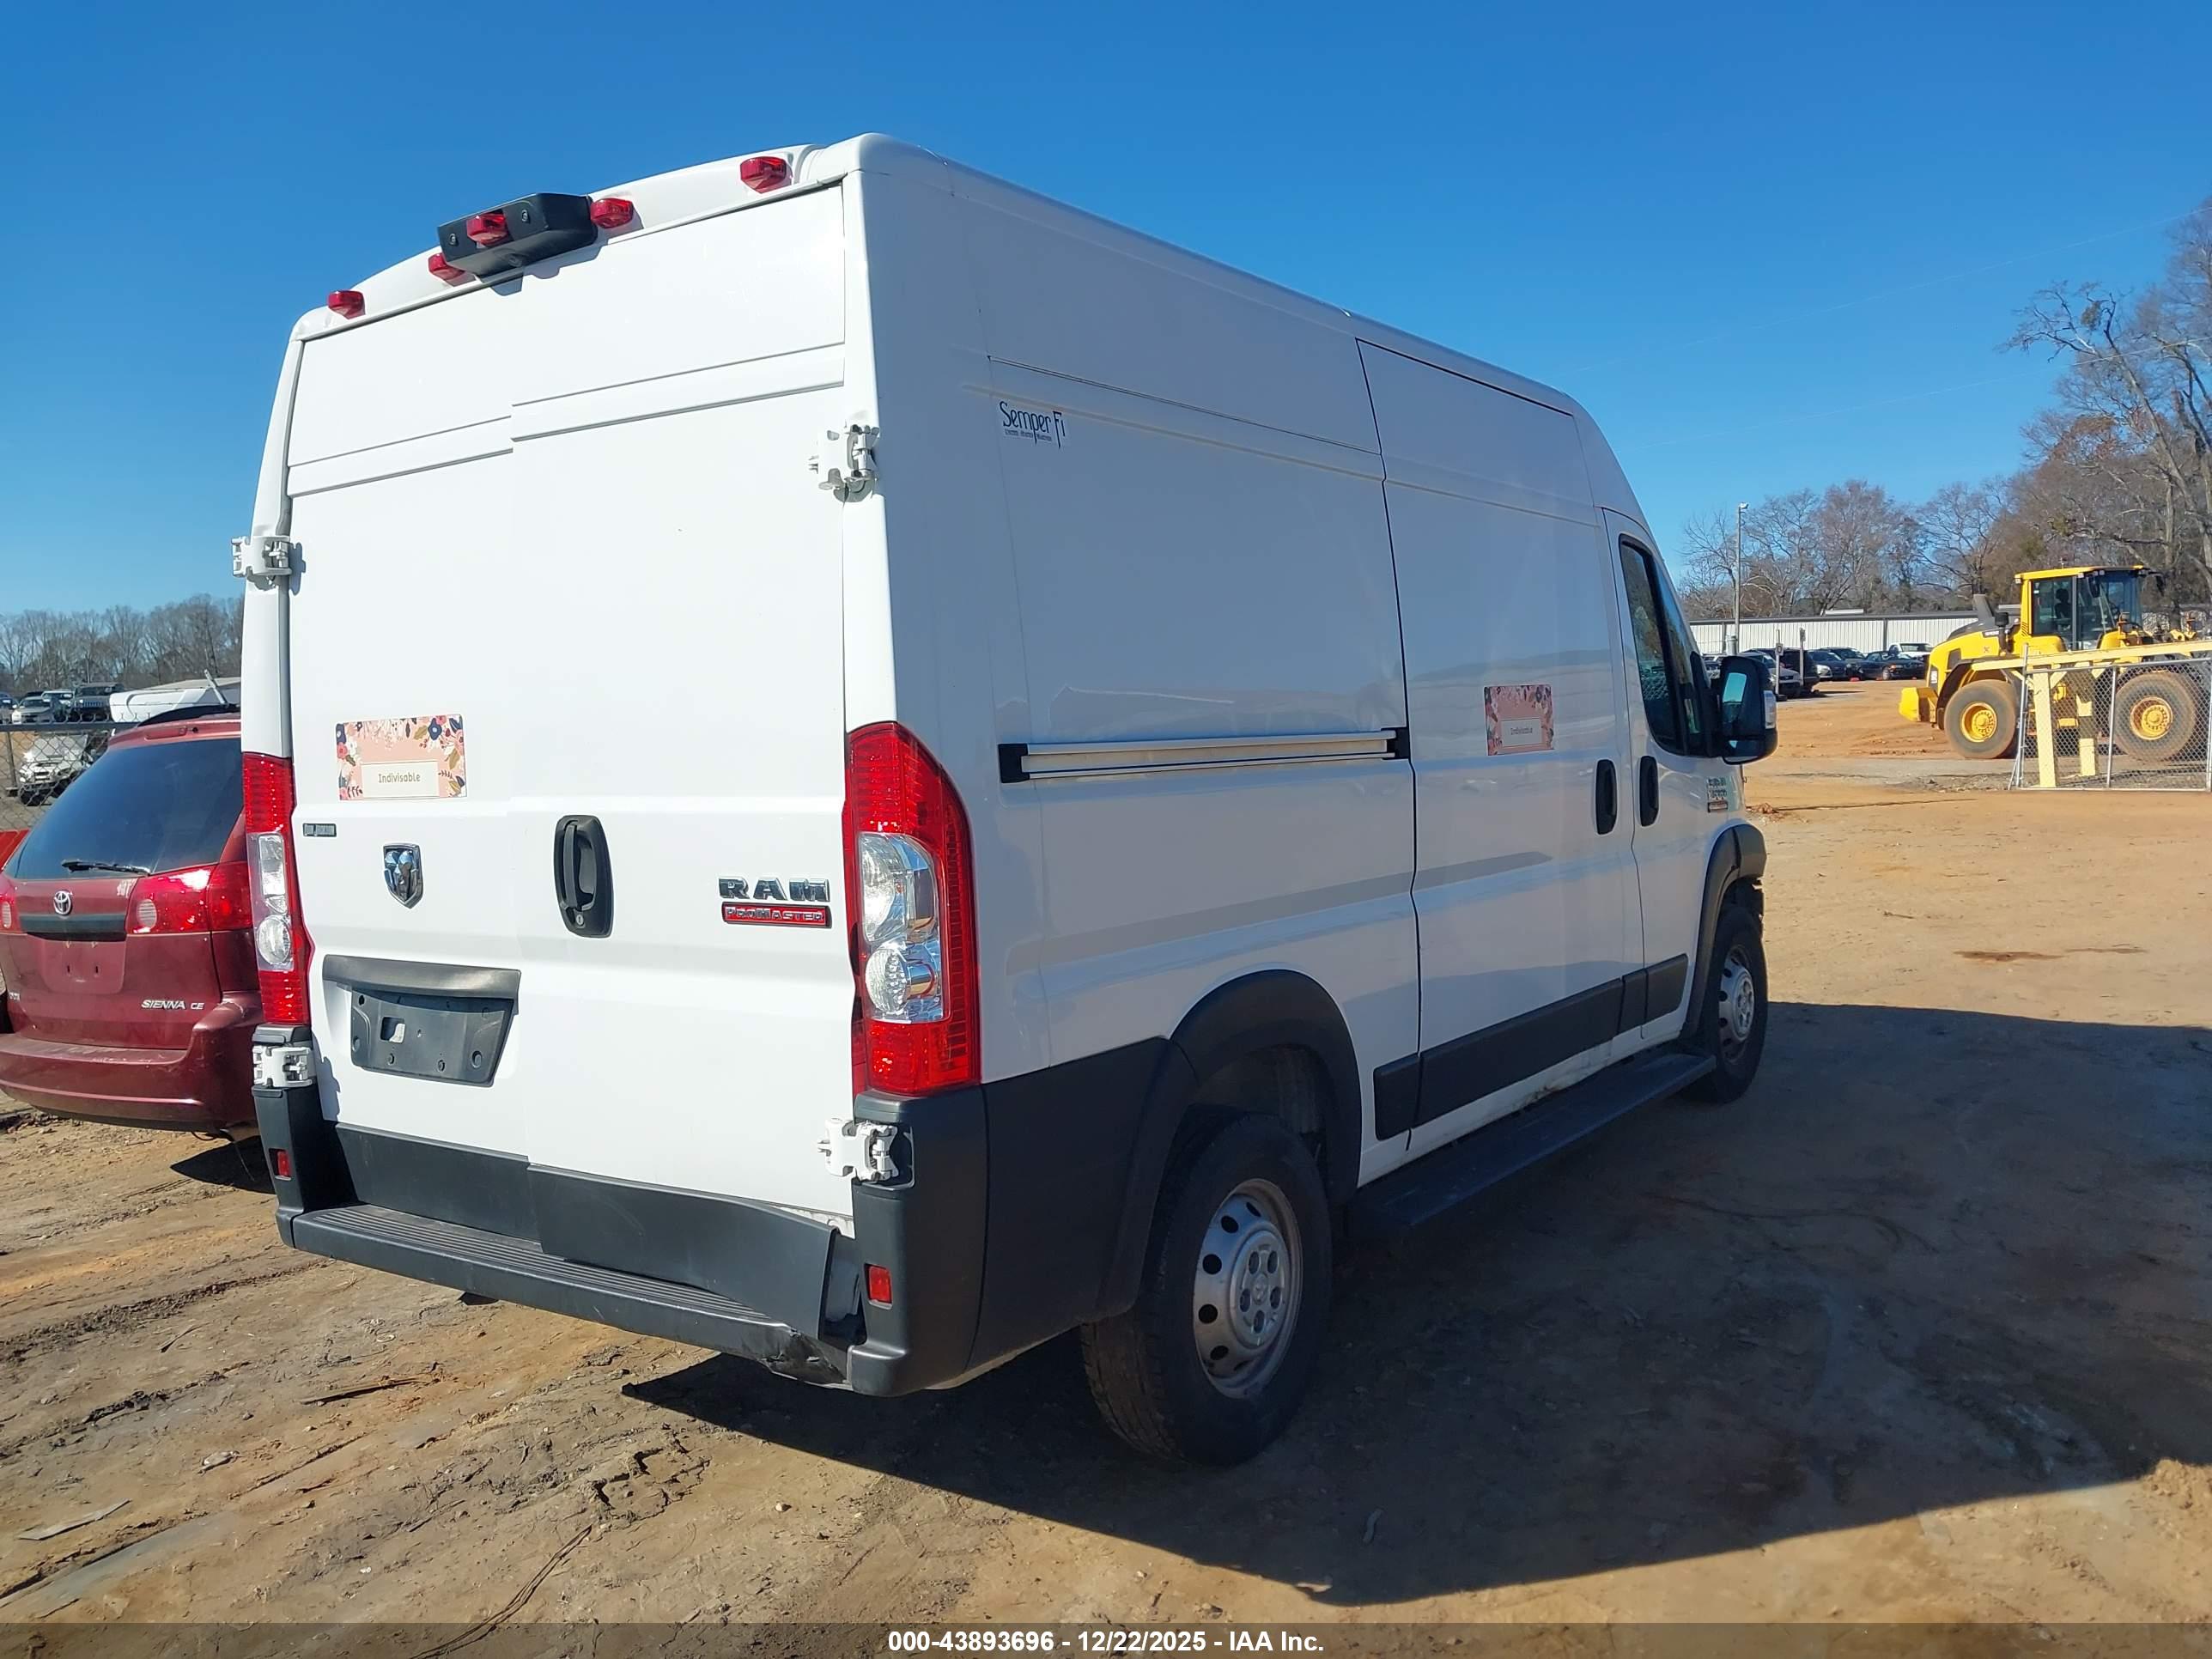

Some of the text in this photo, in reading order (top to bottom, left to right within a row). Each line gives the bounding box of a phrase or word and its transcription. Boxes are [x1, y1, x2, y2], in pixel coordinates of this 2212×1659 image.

[999, 400, 1066, 449] Semper Fi
[378, 772, 421, 783] Indivisable
[718, 877, 831, 902] RAM
[141, 1000, 186, 1010] SIENNA
